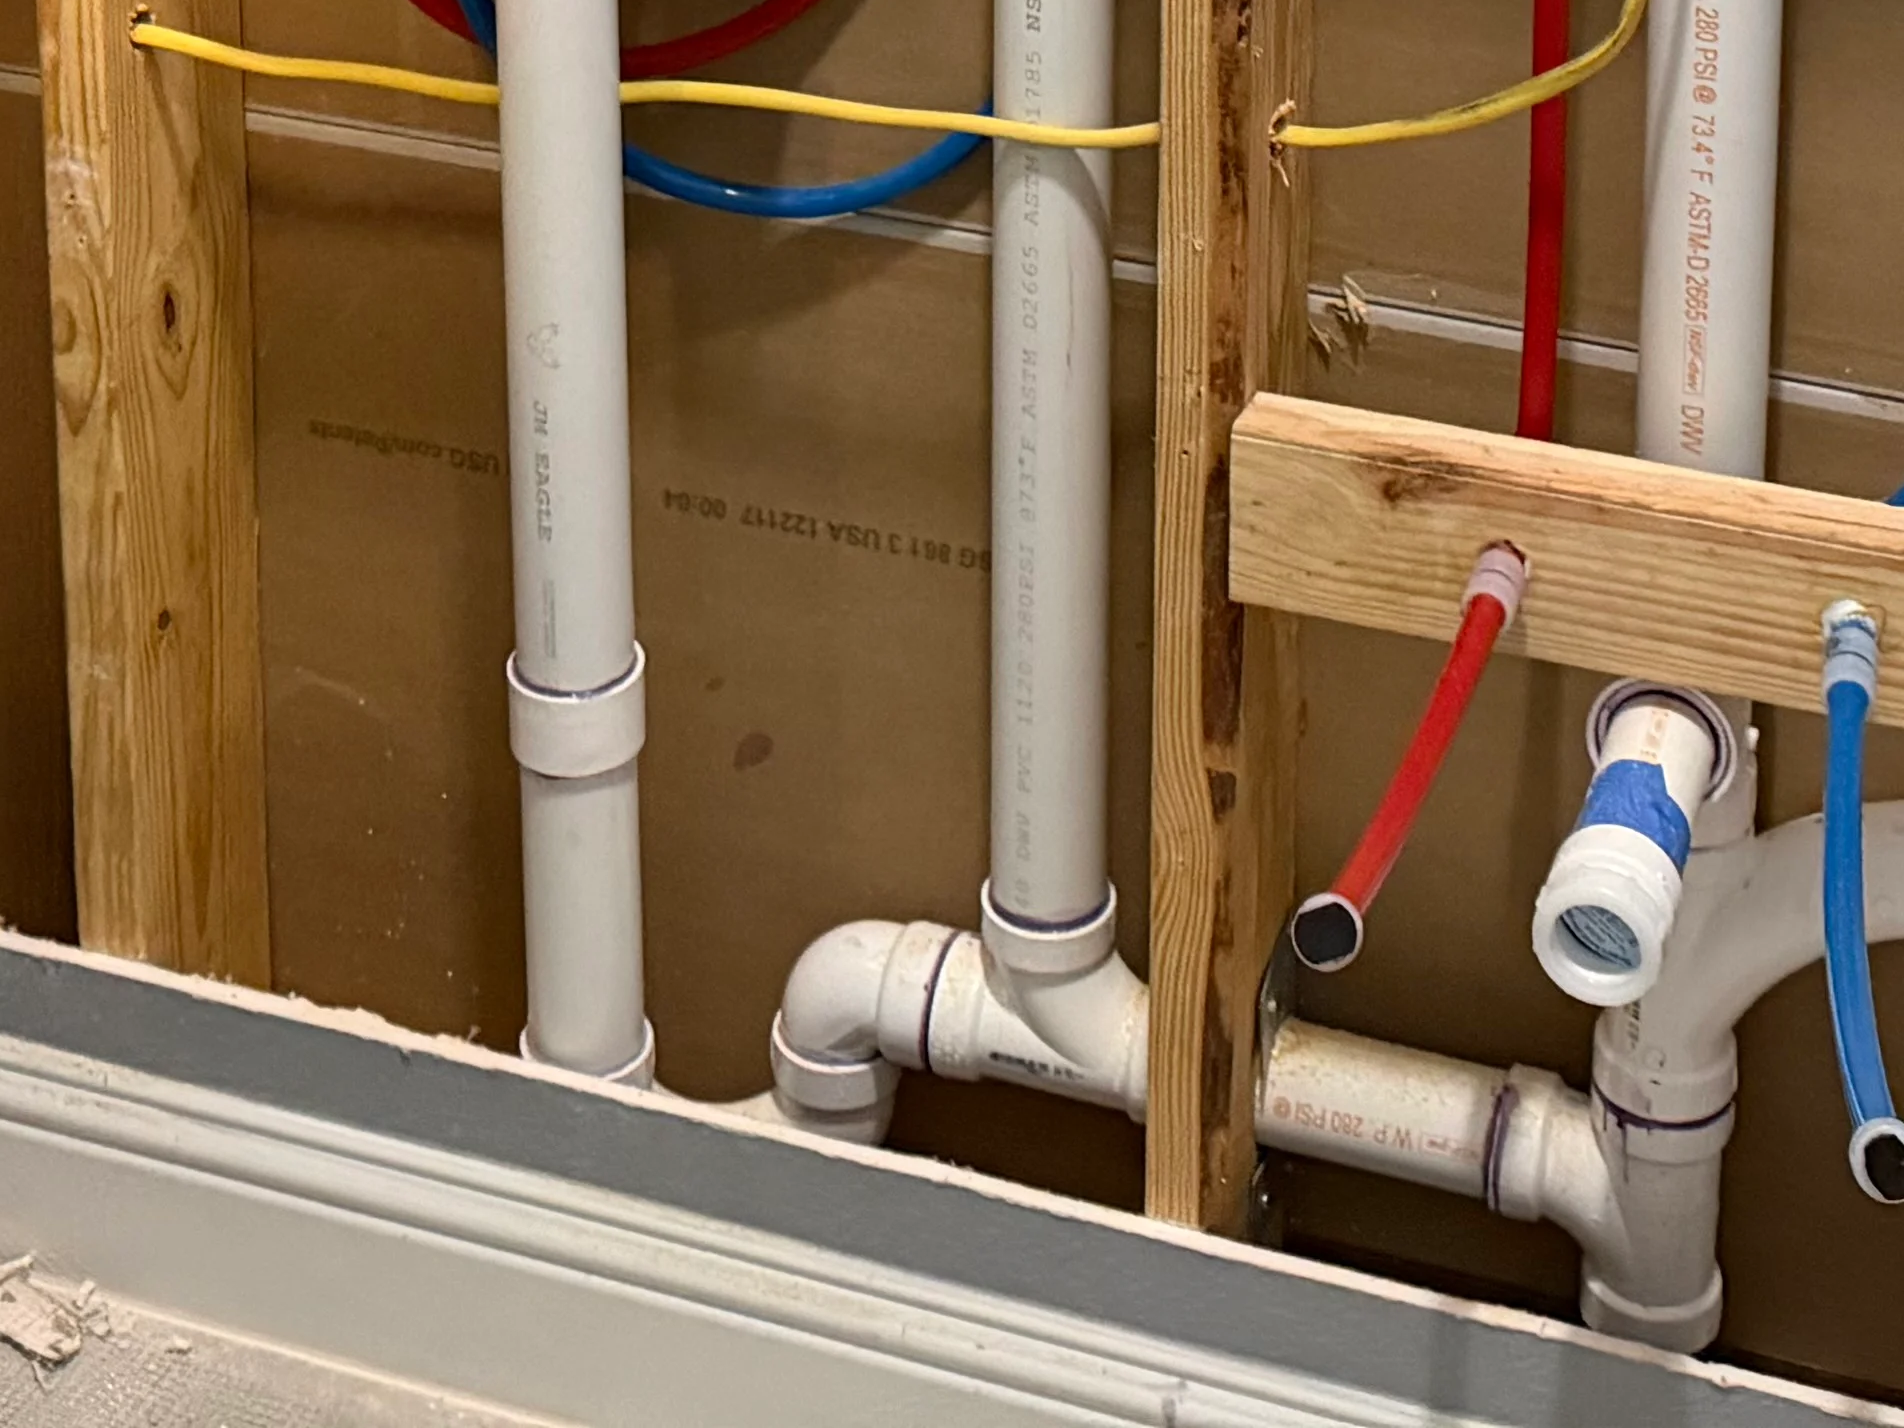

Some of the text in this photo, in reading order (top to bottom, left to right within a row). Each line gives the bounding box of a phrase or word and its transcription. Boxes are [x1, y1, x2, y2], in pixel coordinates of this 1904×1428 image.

[1696, 7, 1719, 41] 280
[1023, 156, 1041, 227] ASTM
[1687, 192, 1711, 270] ASTM-D
[1022, 246, 1039, 331] D2665
[1685, 275, 1708, 322] 2665
[1020, 348, 1038, 421] ASTM
[1680, 404, 1705, 456] DWV
[534, 451, 552, 543] EAGLE
[739, 505, 818, 540] 122117
[826, 521, 881, 550] USA
[1016, 661, 1033, 726] 1120
[1016, 745, 1032, 793] PVC
[1331, 1110, 1364, 1137] 280
